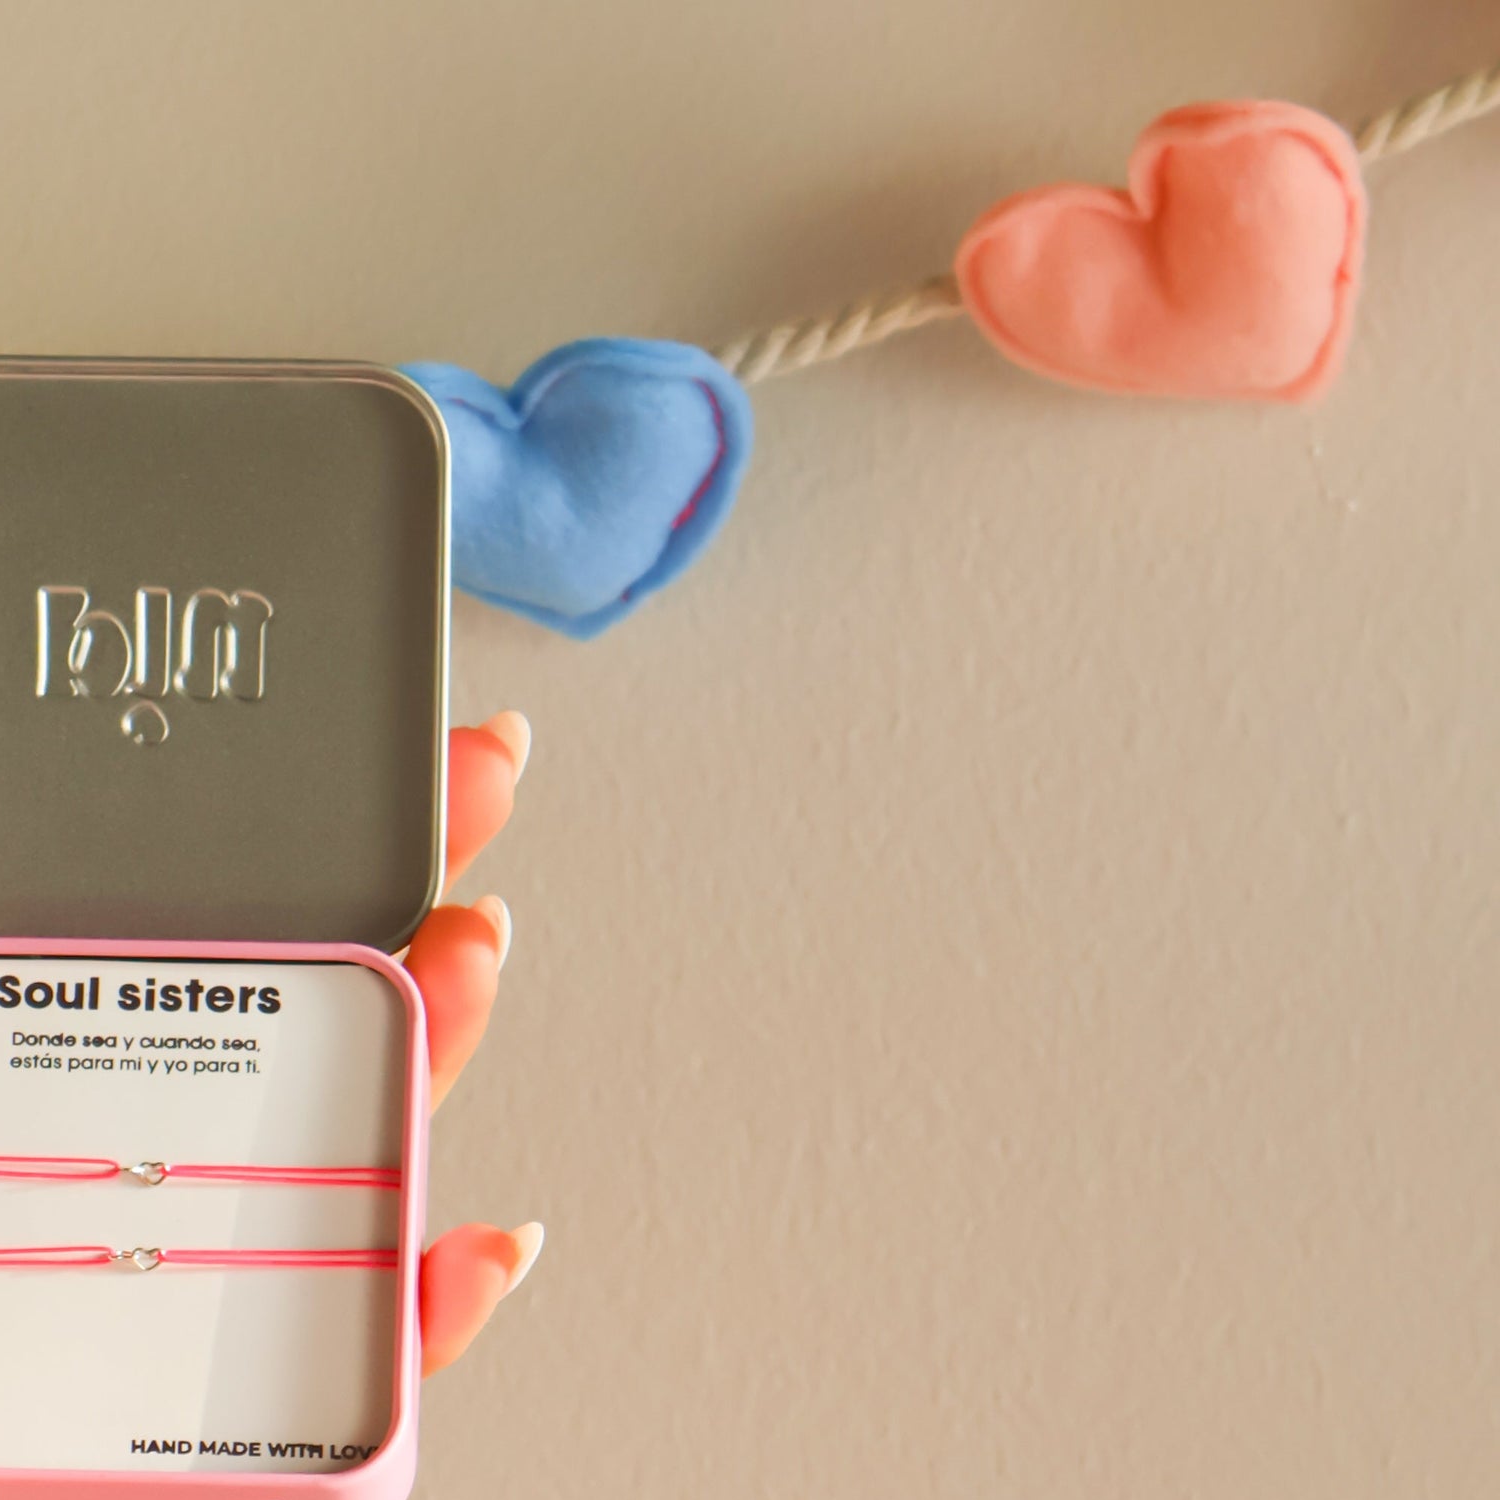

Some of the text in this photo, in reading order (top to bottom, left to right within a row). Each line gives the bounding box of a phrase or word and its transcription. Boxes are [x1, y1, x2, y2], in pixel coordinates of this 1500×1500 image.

[117, 977, 282, 1015] sisters
[11, 1031, 261, 1053] Donde sea y cuando sea,
[9, 1052, 261, 1076] estás para mi y yo para ti.
[130, 1439, 379, 1461] HAND MADE WITH LOV
